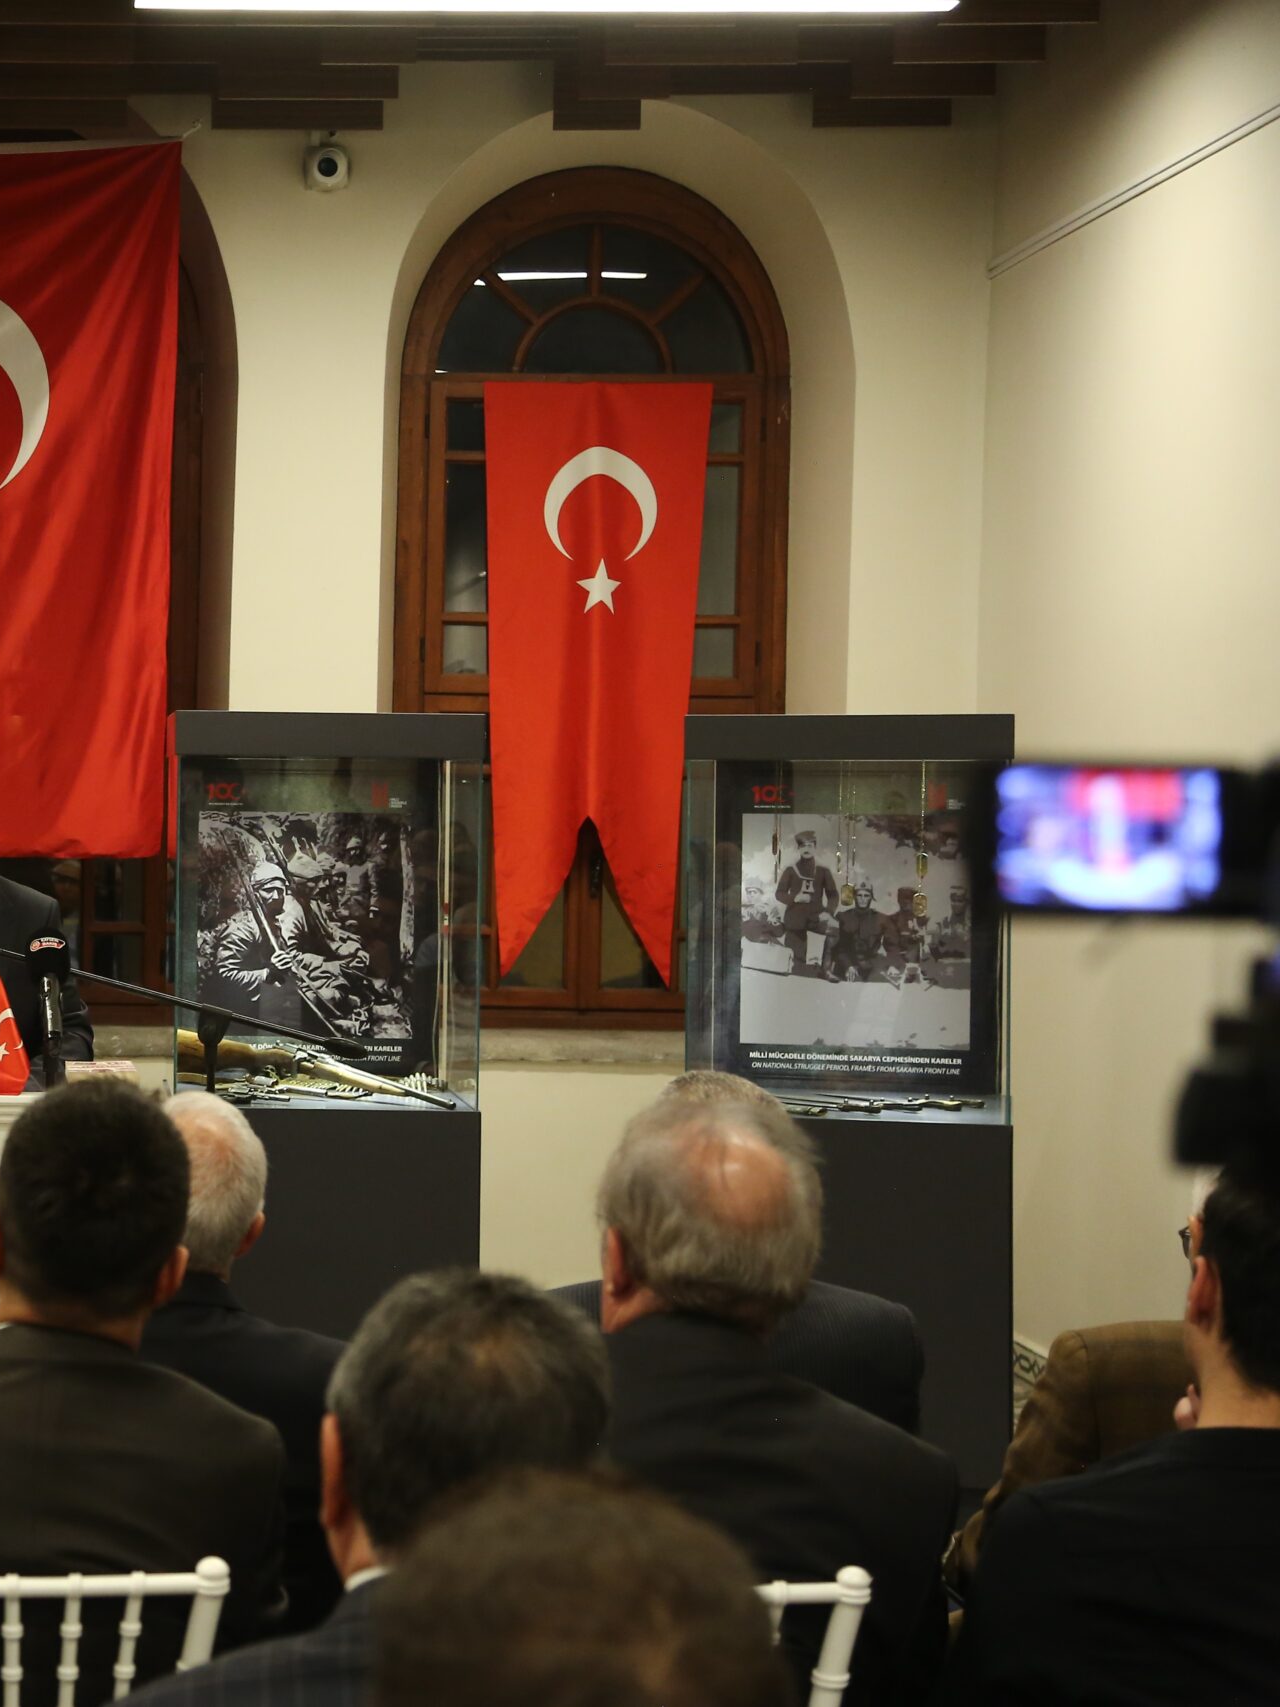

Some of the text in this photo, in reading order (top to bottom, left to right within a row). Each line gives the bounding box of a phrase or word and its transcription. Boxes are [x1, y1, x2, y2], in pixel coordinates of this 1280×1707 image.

[768, 1051, 806, 1060] MÜCADELE
[806, 1053, 848, 1061] DÖNEMİNDE
[882, 1056, 930, 1064] CEPHESİNDEN
[825, 1064, 850, 1072] PERIOD,
